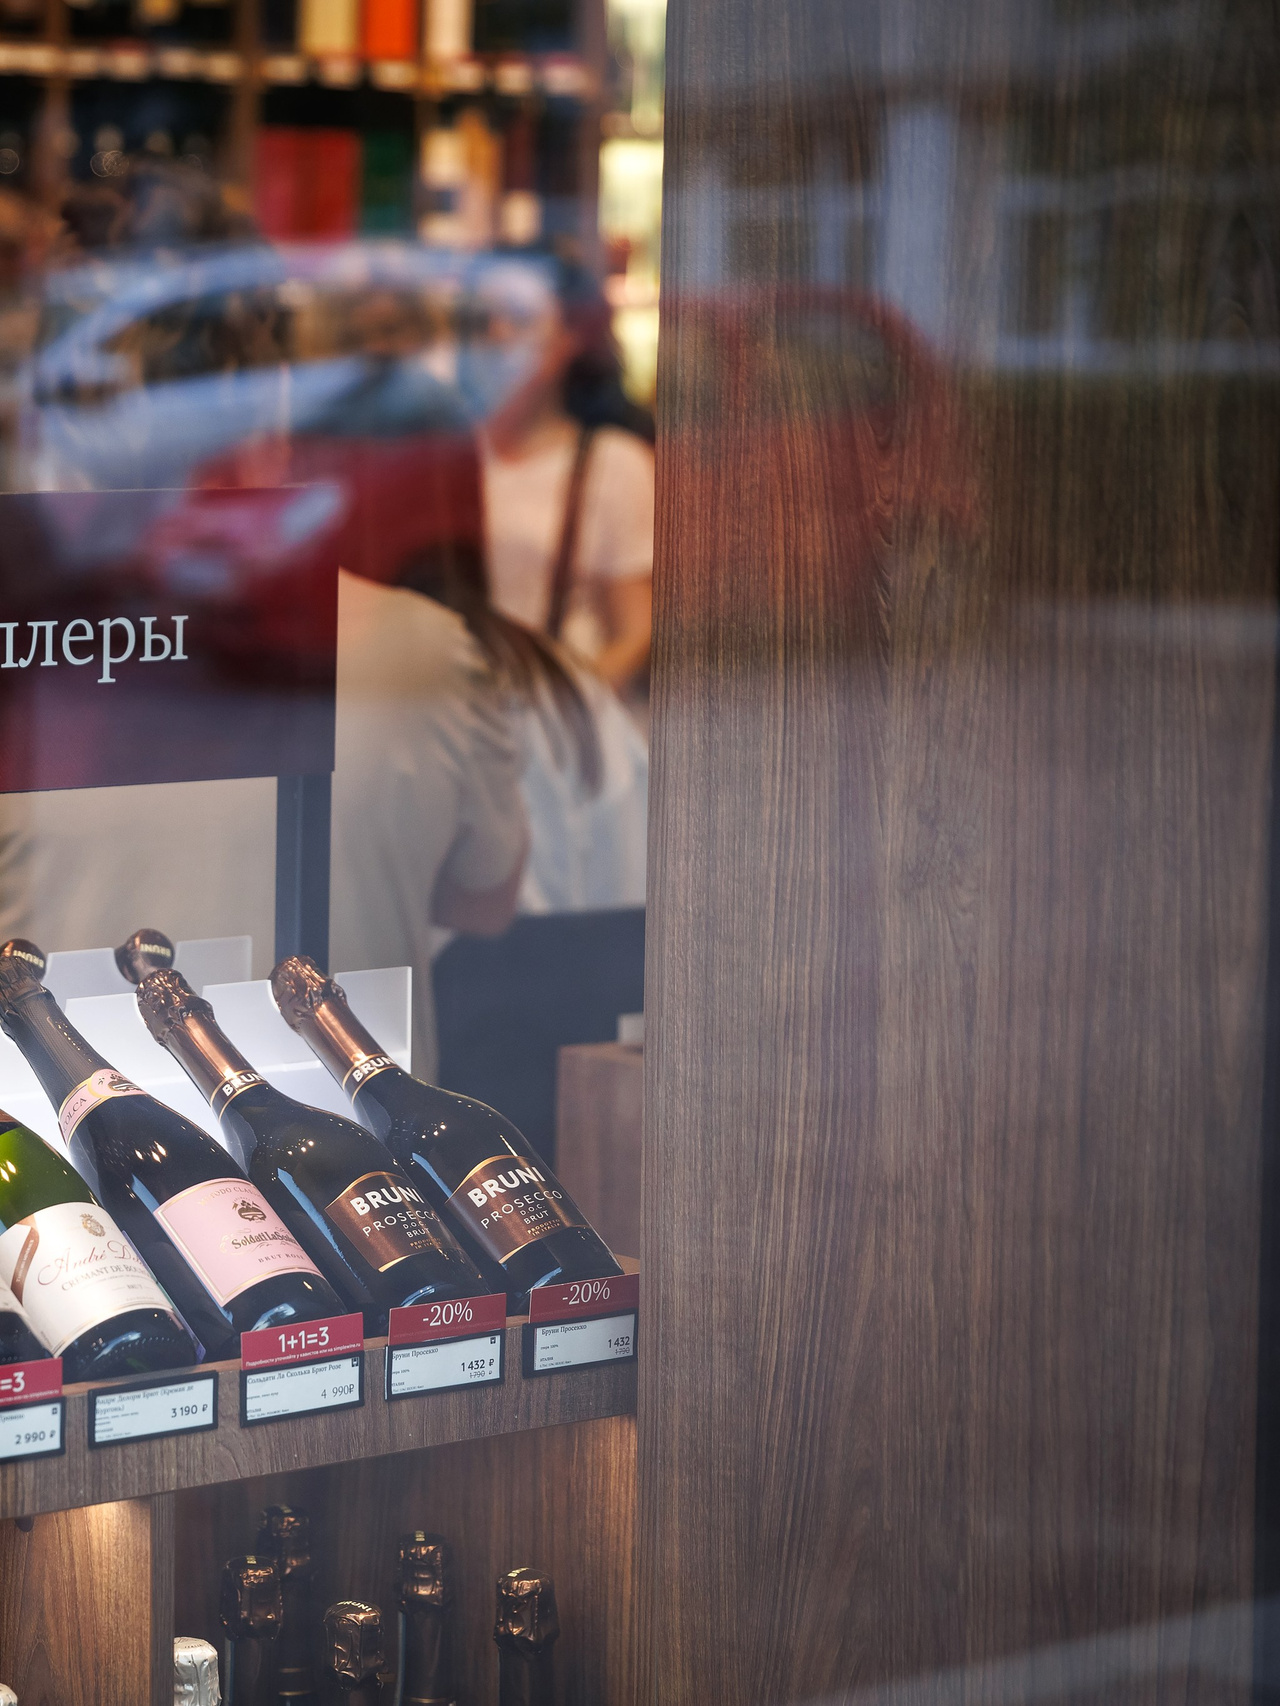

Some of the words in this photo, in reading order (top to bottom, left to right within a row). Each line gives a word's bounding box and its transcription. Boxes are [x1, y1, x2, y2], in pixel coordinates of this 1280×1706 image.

[352, 1056, 397, 1083] BRUN
[467, 1166, 546, 1208] BRUNI
[350, 1186, 425, 1216] BRUNI
[480, 1190, 563, 1230] PROSECCO
[520, 1203, 545, 1216] D.O.C.
[362, 1210, 440, 1237] PROSECCO
[523, 1210, 549, 1225] BRUT
[258, 1253, 282, 1263] BRUT
[562, 1280, 610, 1305] -20%
[422, 1301, 473, 1327] -20%
[278, 1326, 330, 1353] 1+1=3
[541, 1327, 560, 1337] Бруни
[560, 1324, 587, 1334] Просекко
[333, 1343, 361, 1352] simplewine.ru
[411, 1347, 439, 1358] Просекко
[247, 1374, 276, 1385] Сольдати
[276, 1372, 285, 1380] Ла
[286, 1369, 311, 1378] Сколька
[312, 1366, 328, 1376] Брют
[328, 1363, 342, 1371] Розе
